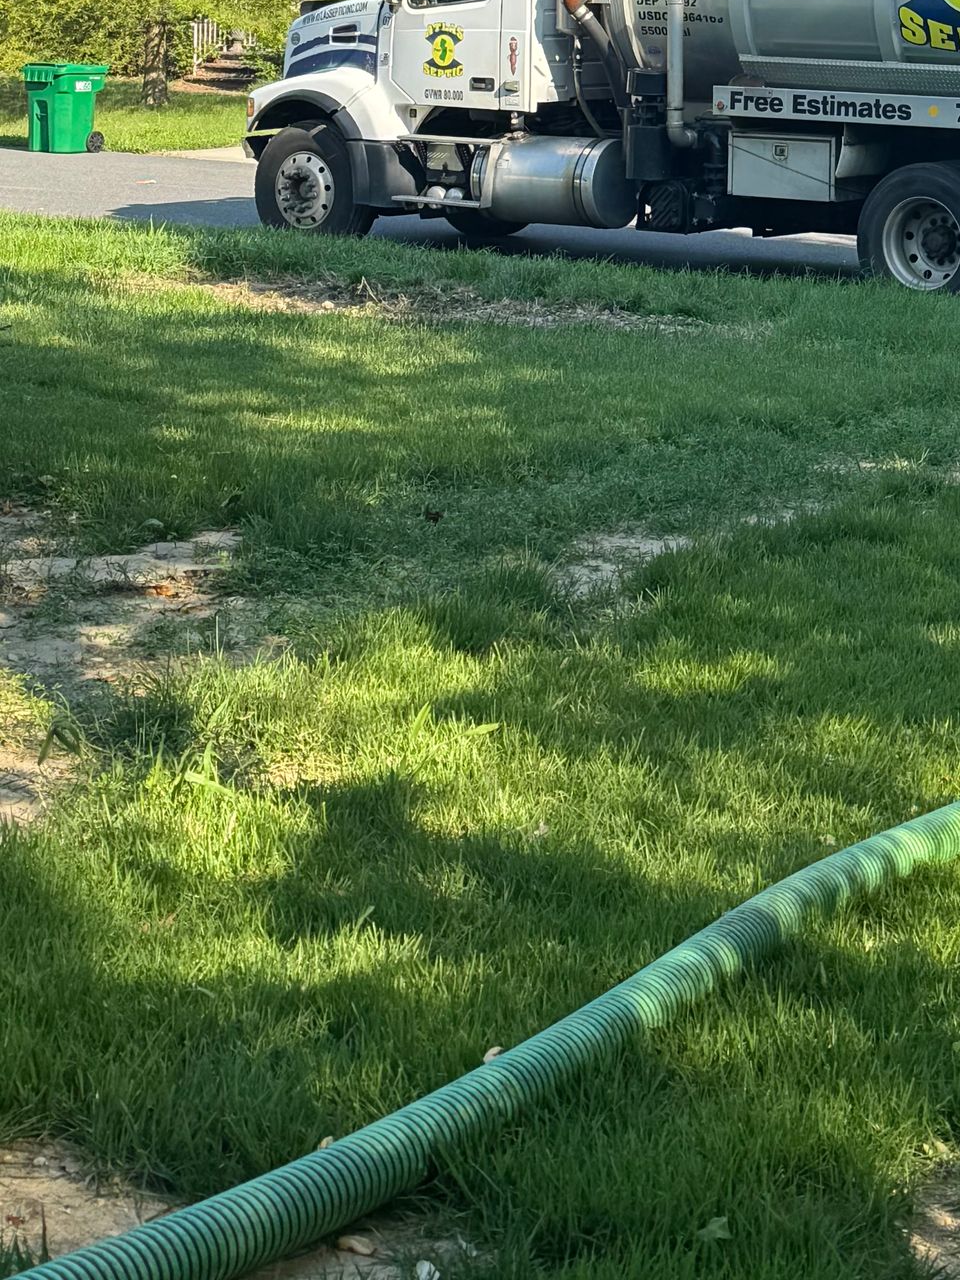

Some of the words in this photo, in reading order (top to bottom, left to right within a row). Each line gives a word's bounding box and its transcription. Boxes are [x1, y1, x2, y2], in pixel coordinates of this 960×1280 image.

[425, 22, 465, 41] ATLAS
[423, 63, 464, 78] SEPTIC
[424, 88, 442, 100] GVWR
[730, 91, 784, 113] Free
[792, 94, 912, 121] Estimates
